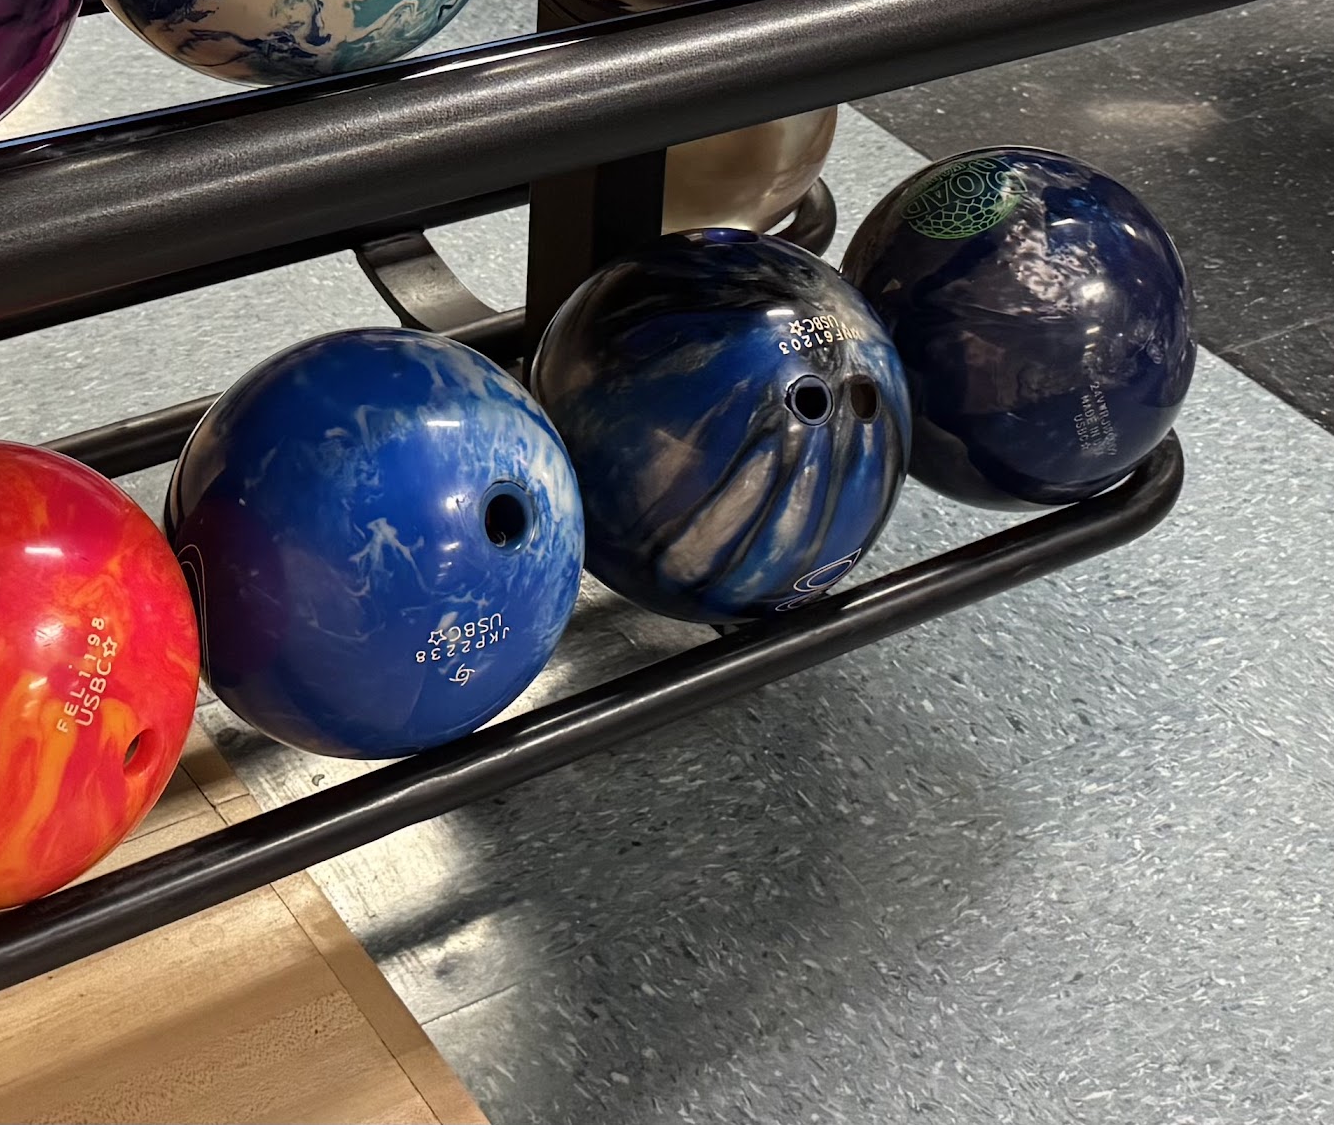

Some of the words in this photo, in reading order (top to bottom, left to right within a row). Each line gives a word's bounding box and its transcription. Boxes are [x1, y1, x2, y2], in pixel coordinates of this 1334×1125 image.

[900, 157, 1028, 220] ROAD
[802, 315, 839, 333] USBC
[1080, 395, 1099, 425] MADE
[1073, 413, 1089, 442] USBC
[449, 613, 502, 642] USBC
[415, 626, 510, 663] JKP2238
[75, 659, 112, 728] USBC
